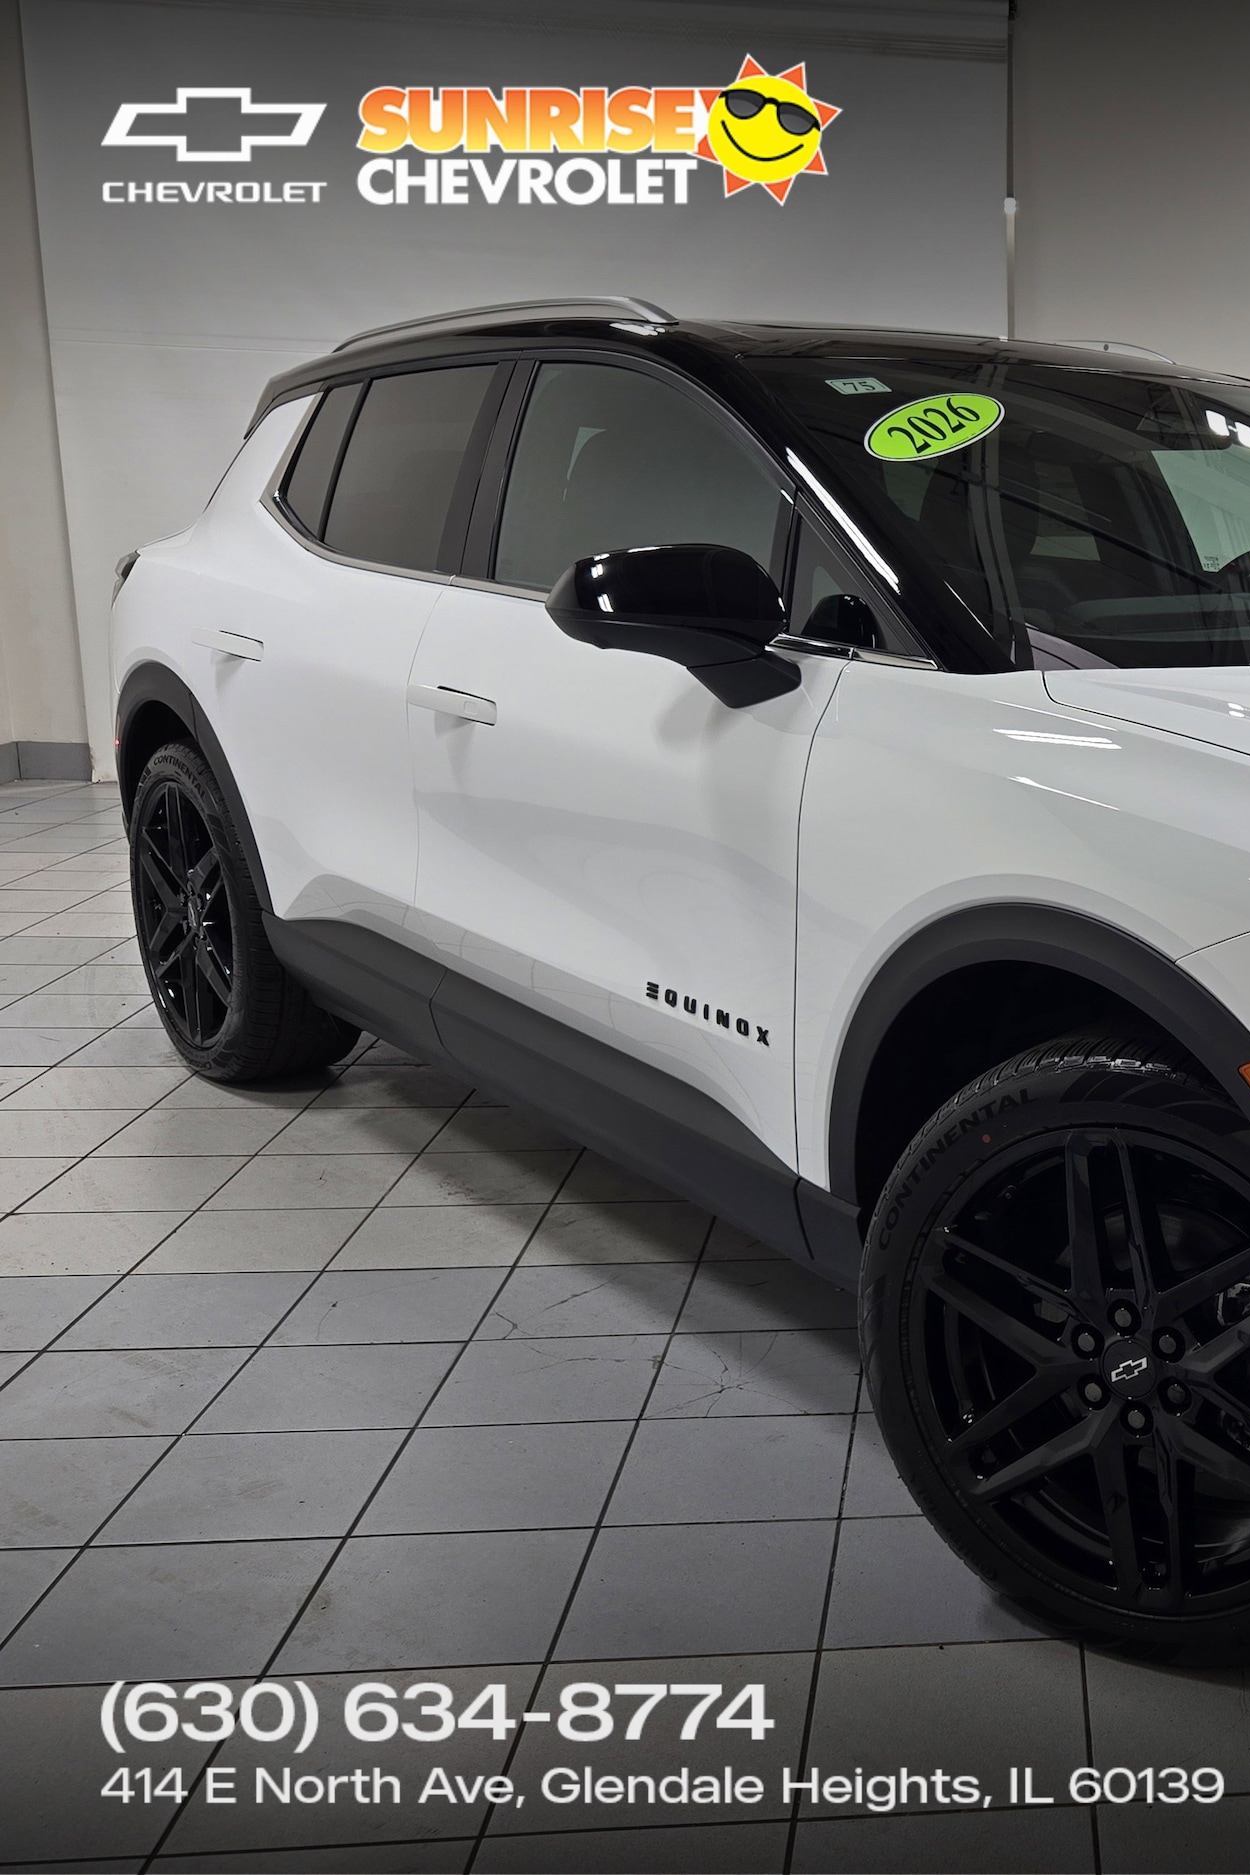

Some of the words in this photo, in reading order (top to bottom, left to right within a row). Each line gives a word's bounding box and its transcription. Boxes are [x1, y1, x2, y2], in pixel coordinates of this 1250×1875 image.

[842, 380, 876, 393] 75
[887, 397, 981, 454] 2026
[153, 754, 206, 798] CONTINENTAL
[645, 981, 770, 1047] EQUINOX
[878, 1088, 1039, 1252] CONTINENTAL
